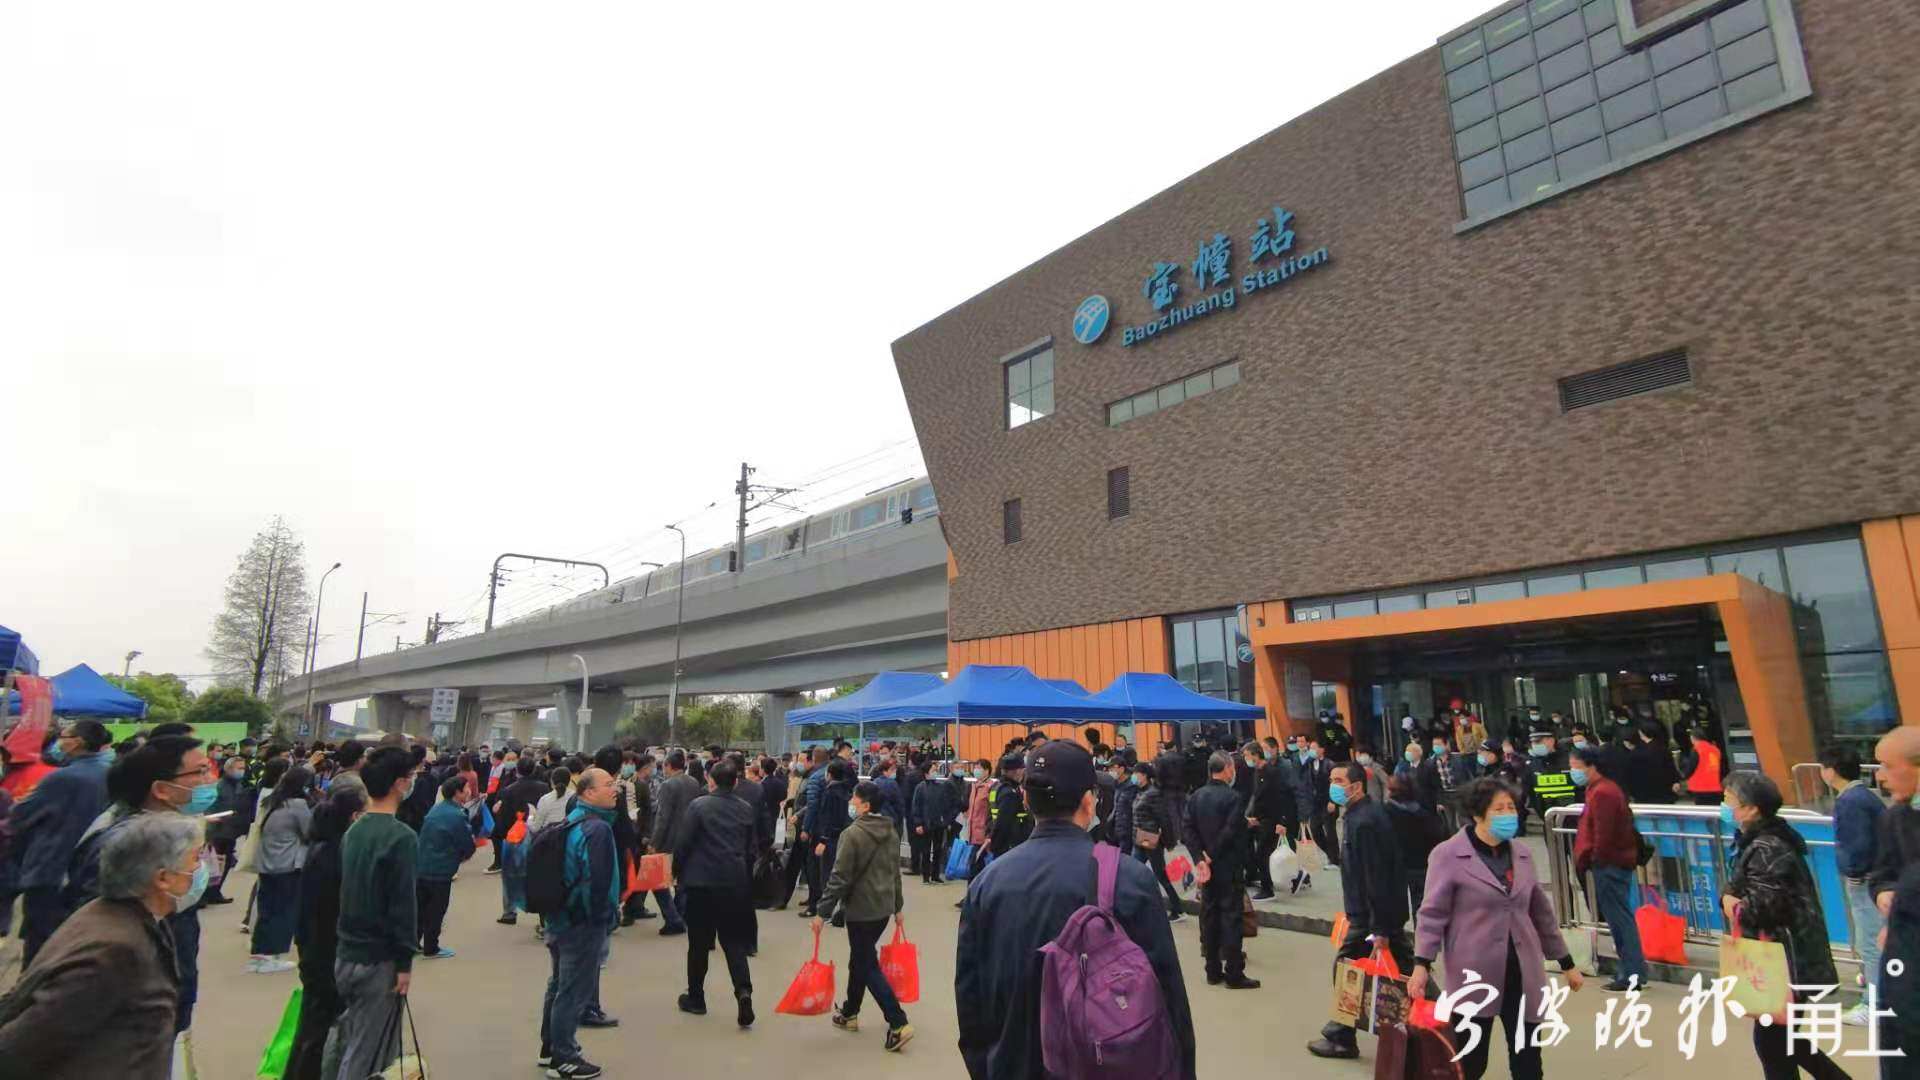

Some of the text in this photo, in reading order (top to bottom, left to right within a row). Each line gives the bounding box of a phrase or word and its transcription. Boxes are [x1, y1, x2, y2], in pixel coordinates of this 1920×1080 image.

[1122, 247, 1329, 345] Baozhuang Station
[1143, 206, 1295, 310] 宝幢站
